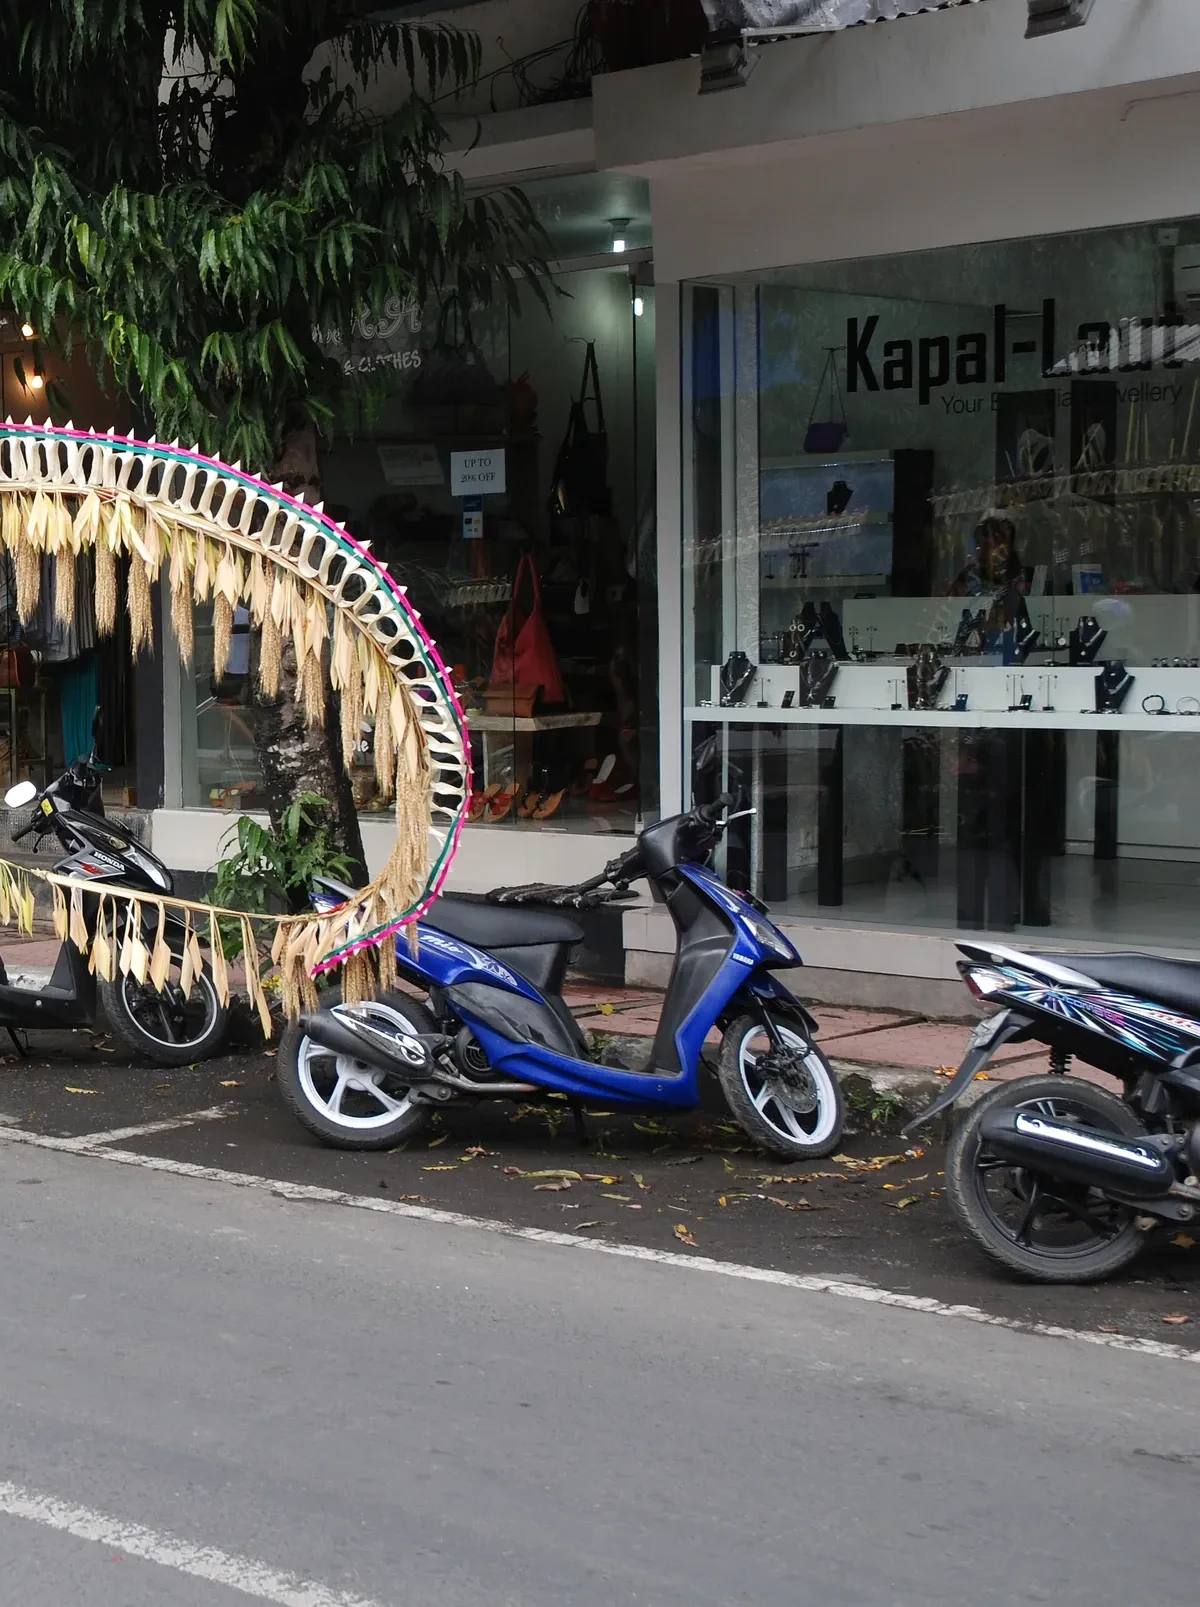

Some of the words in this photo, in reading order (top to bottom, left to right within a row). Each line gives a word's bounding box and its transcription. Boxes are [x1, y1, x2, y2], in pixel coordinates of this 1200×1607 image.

[940, 394, 985, 416] Your
[464, 459, 477, 469] UP
[478, 458, 492, 467] TO
[478, 472, 496, 482] OFF
